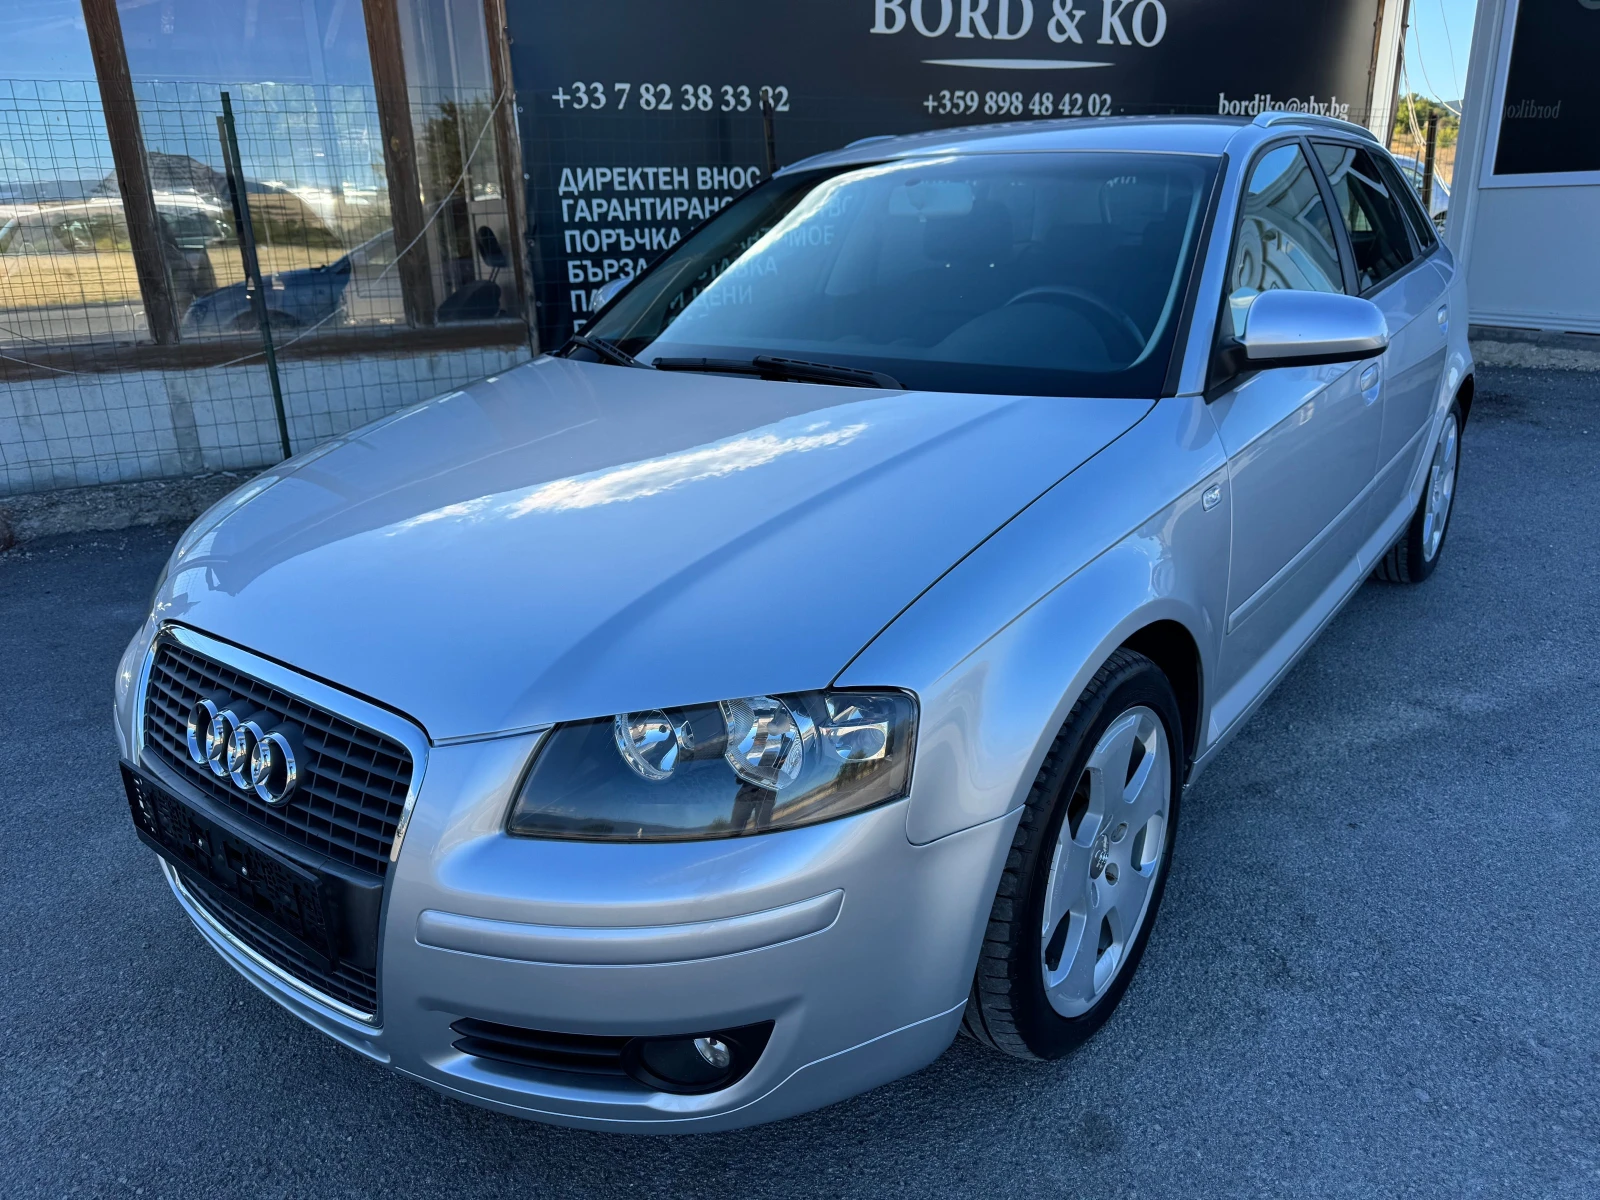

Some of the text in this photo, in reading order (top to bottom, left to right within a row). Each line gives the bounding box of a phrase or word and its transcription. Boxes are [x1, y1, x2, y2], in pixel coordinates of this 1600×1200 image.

[869, 0, 1168, 47] BORD & KO
[552, 81, 607, 110] +33
[614, 82, 631, 110] 7
[639, 83, 673, 111] 82
[681, 84, 713, 112] 38
[720, 85, 751, 112] 33
[923, 89, 1112, 116] +359 898 48 42 02
[558, 166, 761, 197] ДИРЕКТЕН ВНОС
[564, 226, 682, 254] ПОРЪЧКА
[567, 257, 649, 284] БЪРЗА
